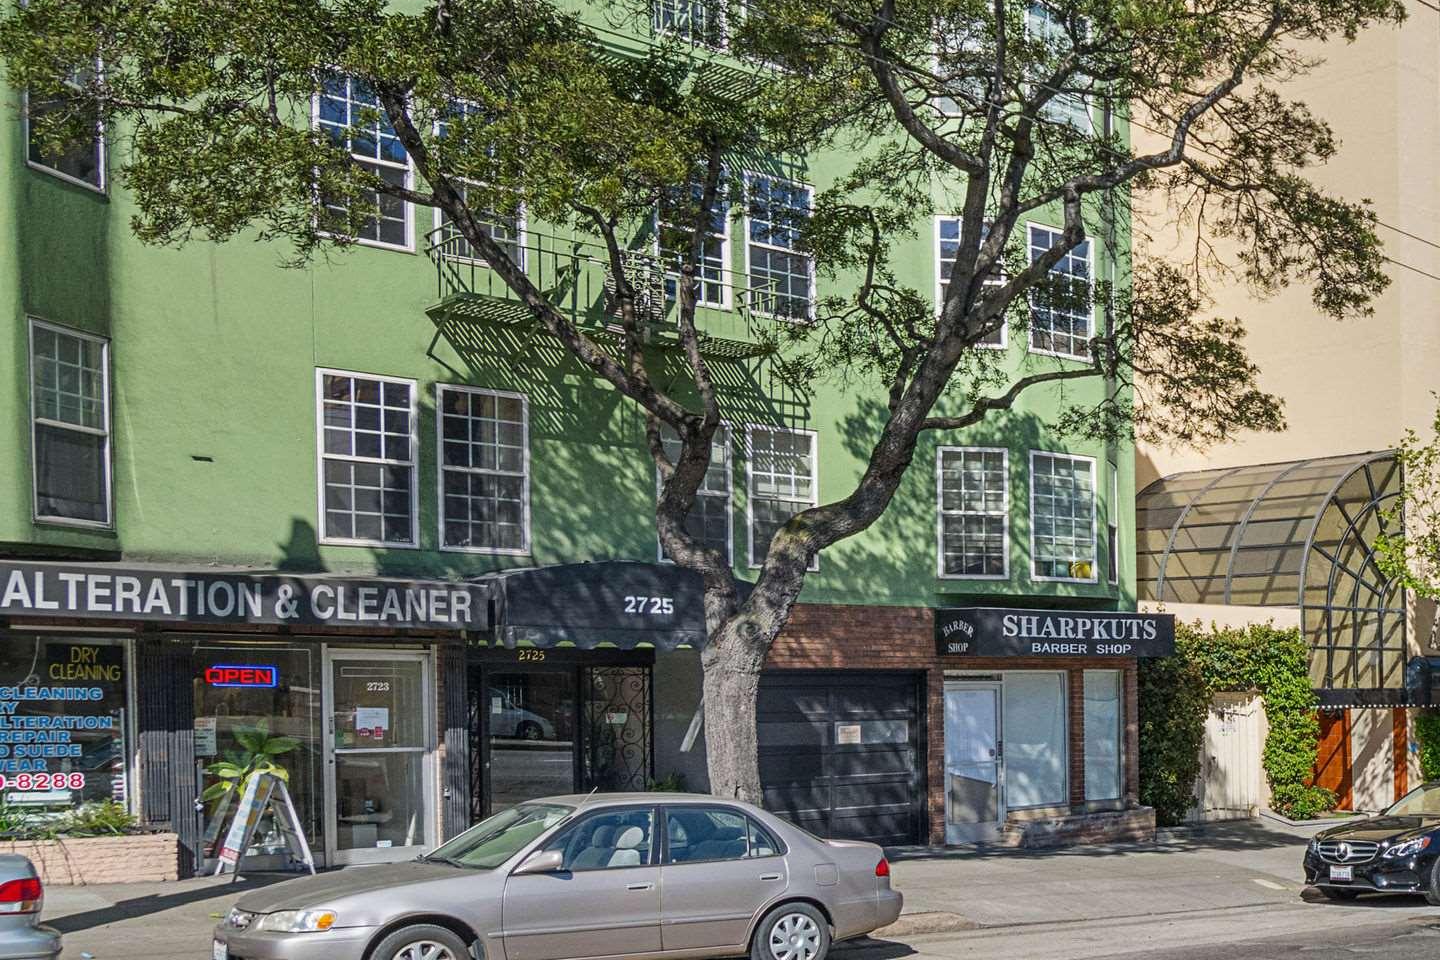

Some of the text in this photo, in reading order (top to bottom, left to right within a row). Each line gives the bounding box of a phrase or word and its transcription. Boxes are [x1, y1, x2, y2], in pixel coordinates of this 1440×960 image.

[1, 570, 472, 623] ALTERATION & CLEANER
[623, 595, 674, 615] 2725
[943, 618, 974, 638] BARBER
[1002, 614, 1157, 640] SHARPKUTS
[71, 646, 99, 663] DRY
[518, 649, 546, 661] 2725
[948, 642, 969, 653] SHOP
[1032, 643, 1132, 654] BARBER SHOP
[50, 663, 121, 681] CLEANING
[205, 667, 272, 684] OPEN
[0, 686, 103, 700] CLEANING
[366, 681, 390, 691] 2723
[15, 744, 82, 757] SUEDE
